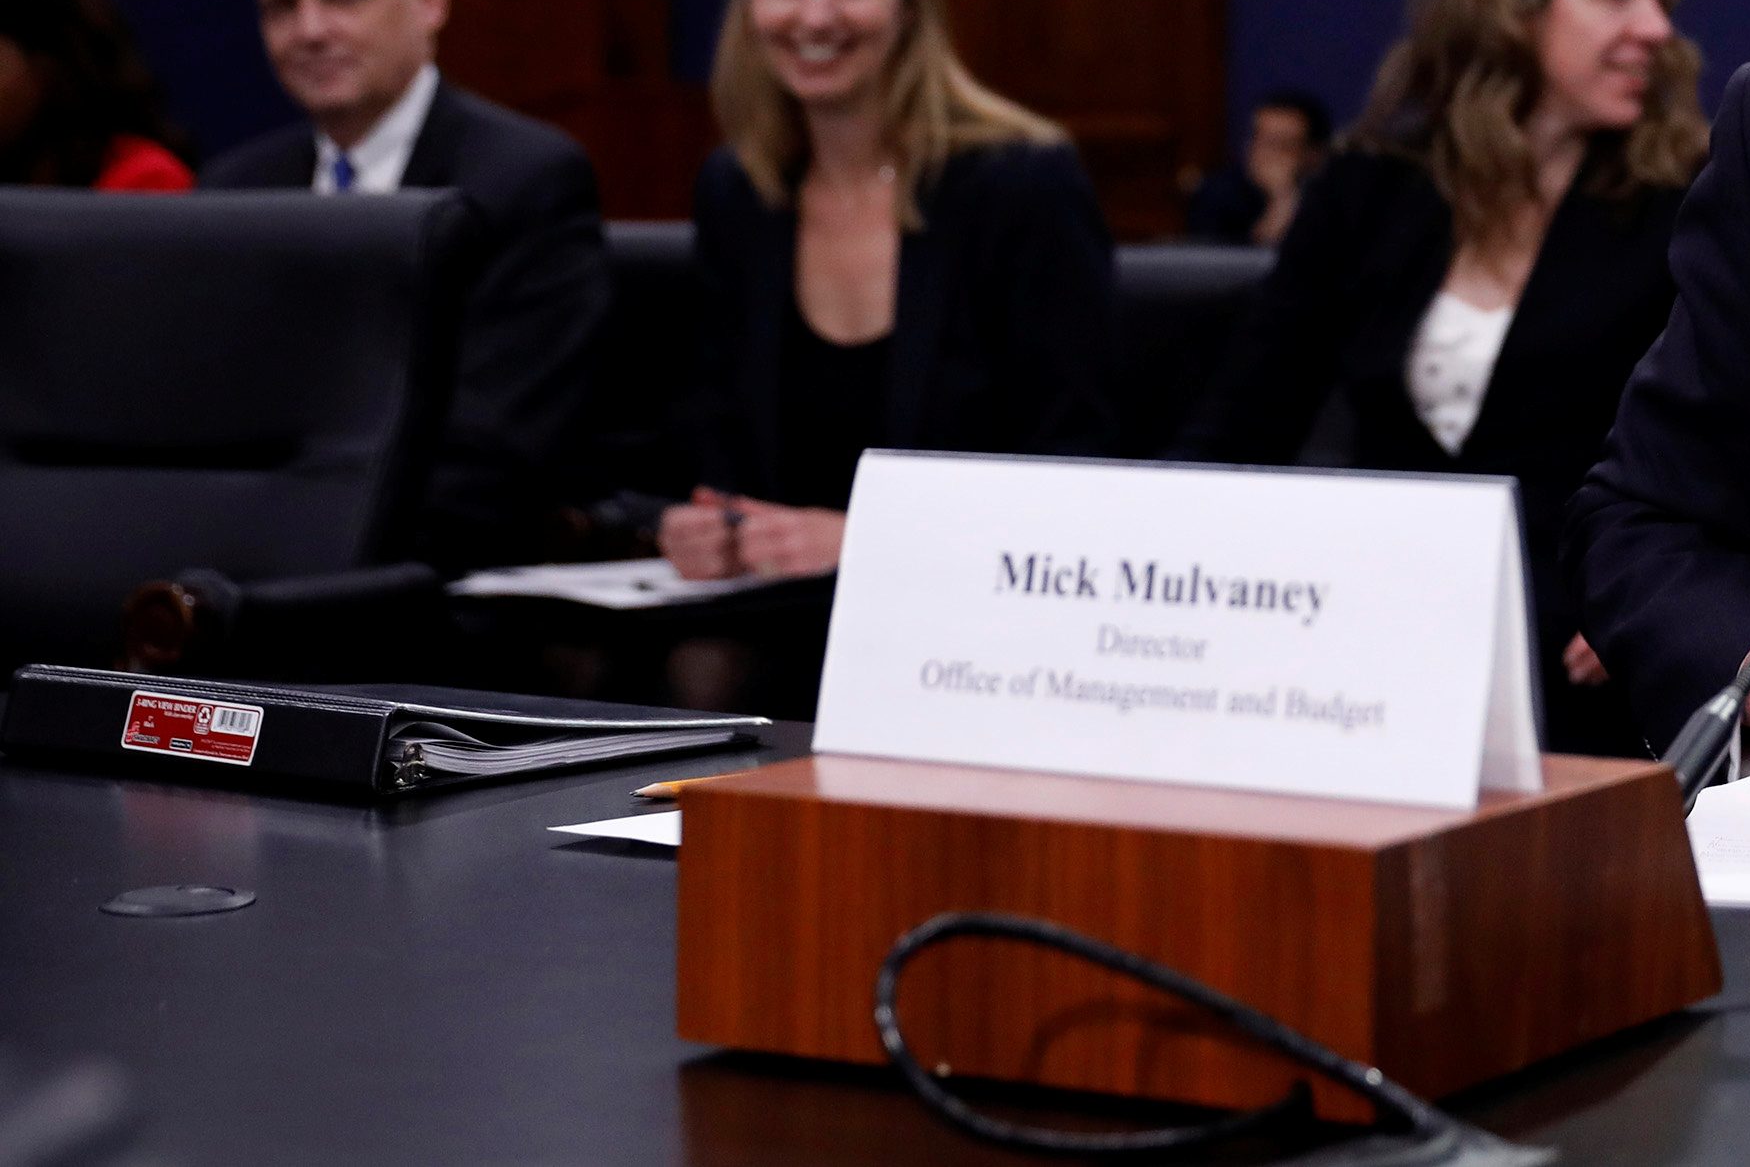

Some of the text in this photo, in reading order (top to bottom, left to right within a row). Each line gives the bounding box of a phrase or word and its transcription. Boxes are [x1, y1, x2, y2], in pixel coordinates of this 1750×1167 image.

[996, 552, 1328, 625] Mick Mulvaney
[1097, 623, 1207, 660] Director
[920, 659, 1385, 731] Office of Management and Budget
